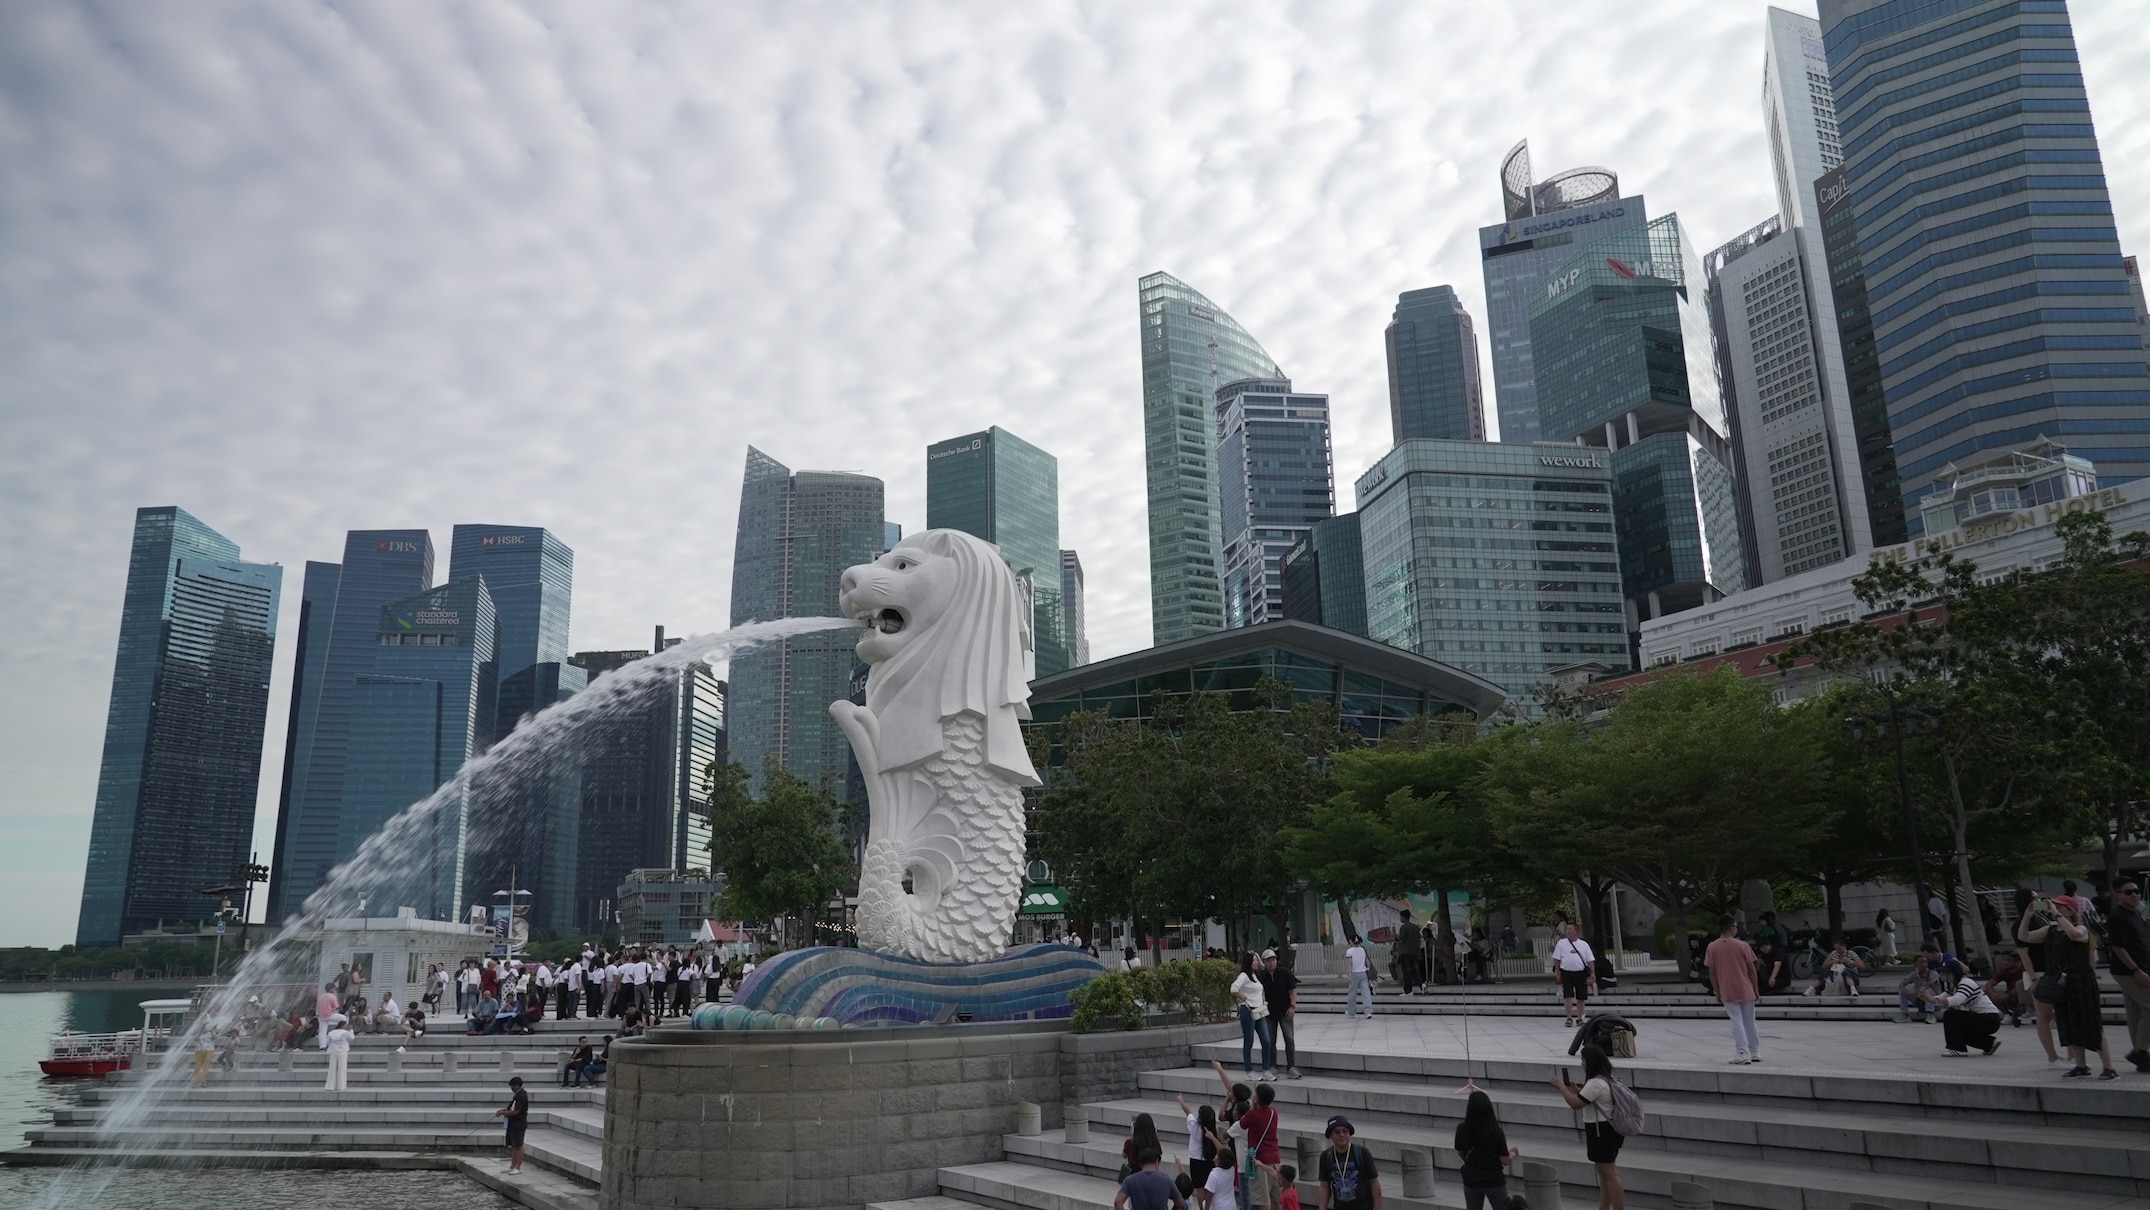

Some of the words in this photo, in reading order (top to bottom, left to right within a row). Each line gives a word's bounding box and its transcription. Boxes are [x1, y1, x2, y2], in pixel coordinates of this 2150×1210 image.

[1523, 208, 1624, 235] SINGAPORELAND
[1547, 268, 1579, 298] MYP
[930, 449, 955, 460] Deutsche
[956, 445, 971, 454] Bank
[1540, 453, 1602, 468] wework
[1870, 546, 1907, 564] THE
[2044, 487, 2126, 522] HOTEL
[389, 540, 417, 552] DBS
[497, 535, 525, 545] HSBC
[415, 617, 460, 625] chartered
[621, 652, 645, 660] MUFG
[1036, 913, 1065, 921] BURGER
